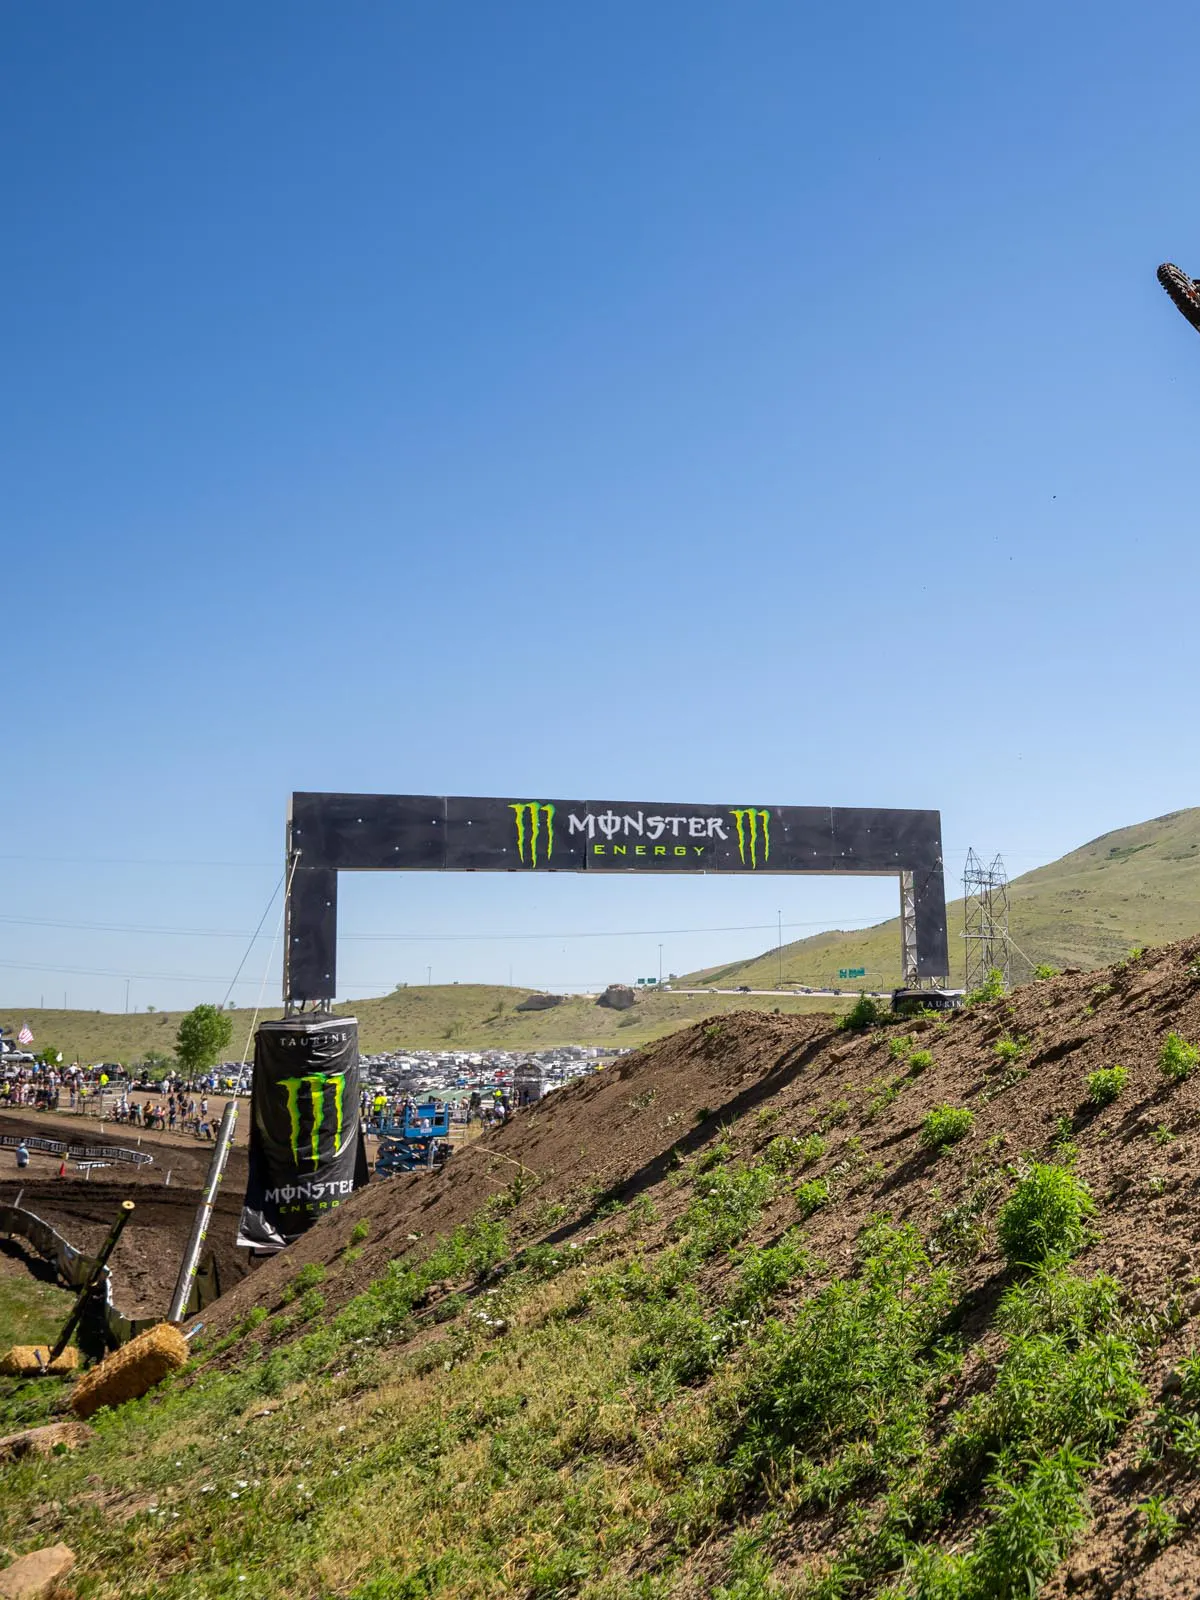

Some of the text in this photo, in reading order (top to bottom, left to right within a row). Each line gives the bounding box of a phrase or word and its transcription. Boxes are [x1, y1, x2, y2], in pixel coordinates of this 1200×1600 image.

[567, 810, 729, 840] MONSTER
[593, 844, 705, 856] ENERGY
[919, 1000, 963, 1008] TAURIN
[280, 1032, 348, 1046] TAURINE
[279, 1200, 340, 1213] ENERG
